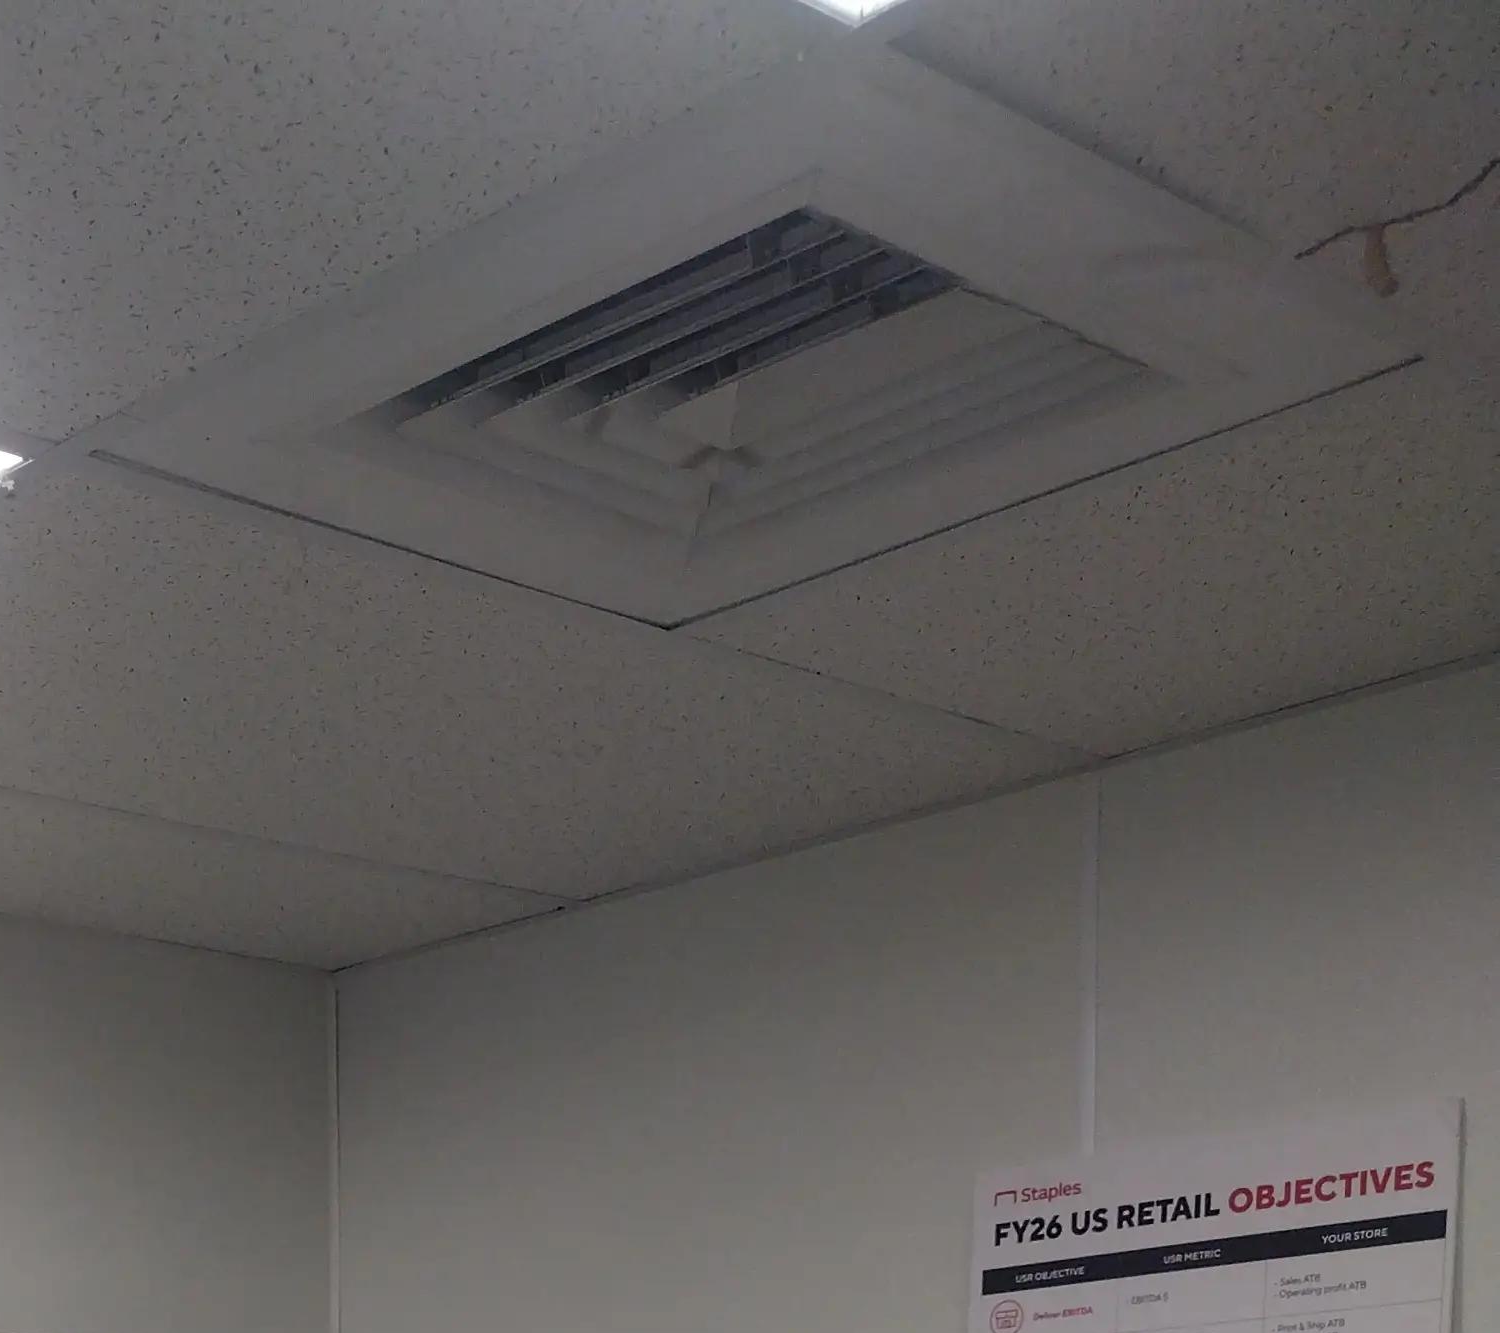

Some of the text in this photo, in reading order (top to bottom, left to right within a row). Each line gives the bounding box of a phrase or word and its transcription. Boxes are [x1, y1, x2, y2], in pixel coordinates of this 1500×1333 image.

[1021, 1182, 1082, 1202] Staples
[995, 1161, 1435, 1246] FY26 US RETAIL OBJECTIVES
[1321, 1227, 1388, 1245] YOUR STORE
[1163, 1248, 1221, 1265] USR METRIC
[1016, 1266, 1084, 1283] USR OBJECTIVE
[1279, 1286, 1321, 1299] Operating
[1349, 1280, 1367, 1290] ATB
[1062, 1306, 1093, 1318] EBITDA
